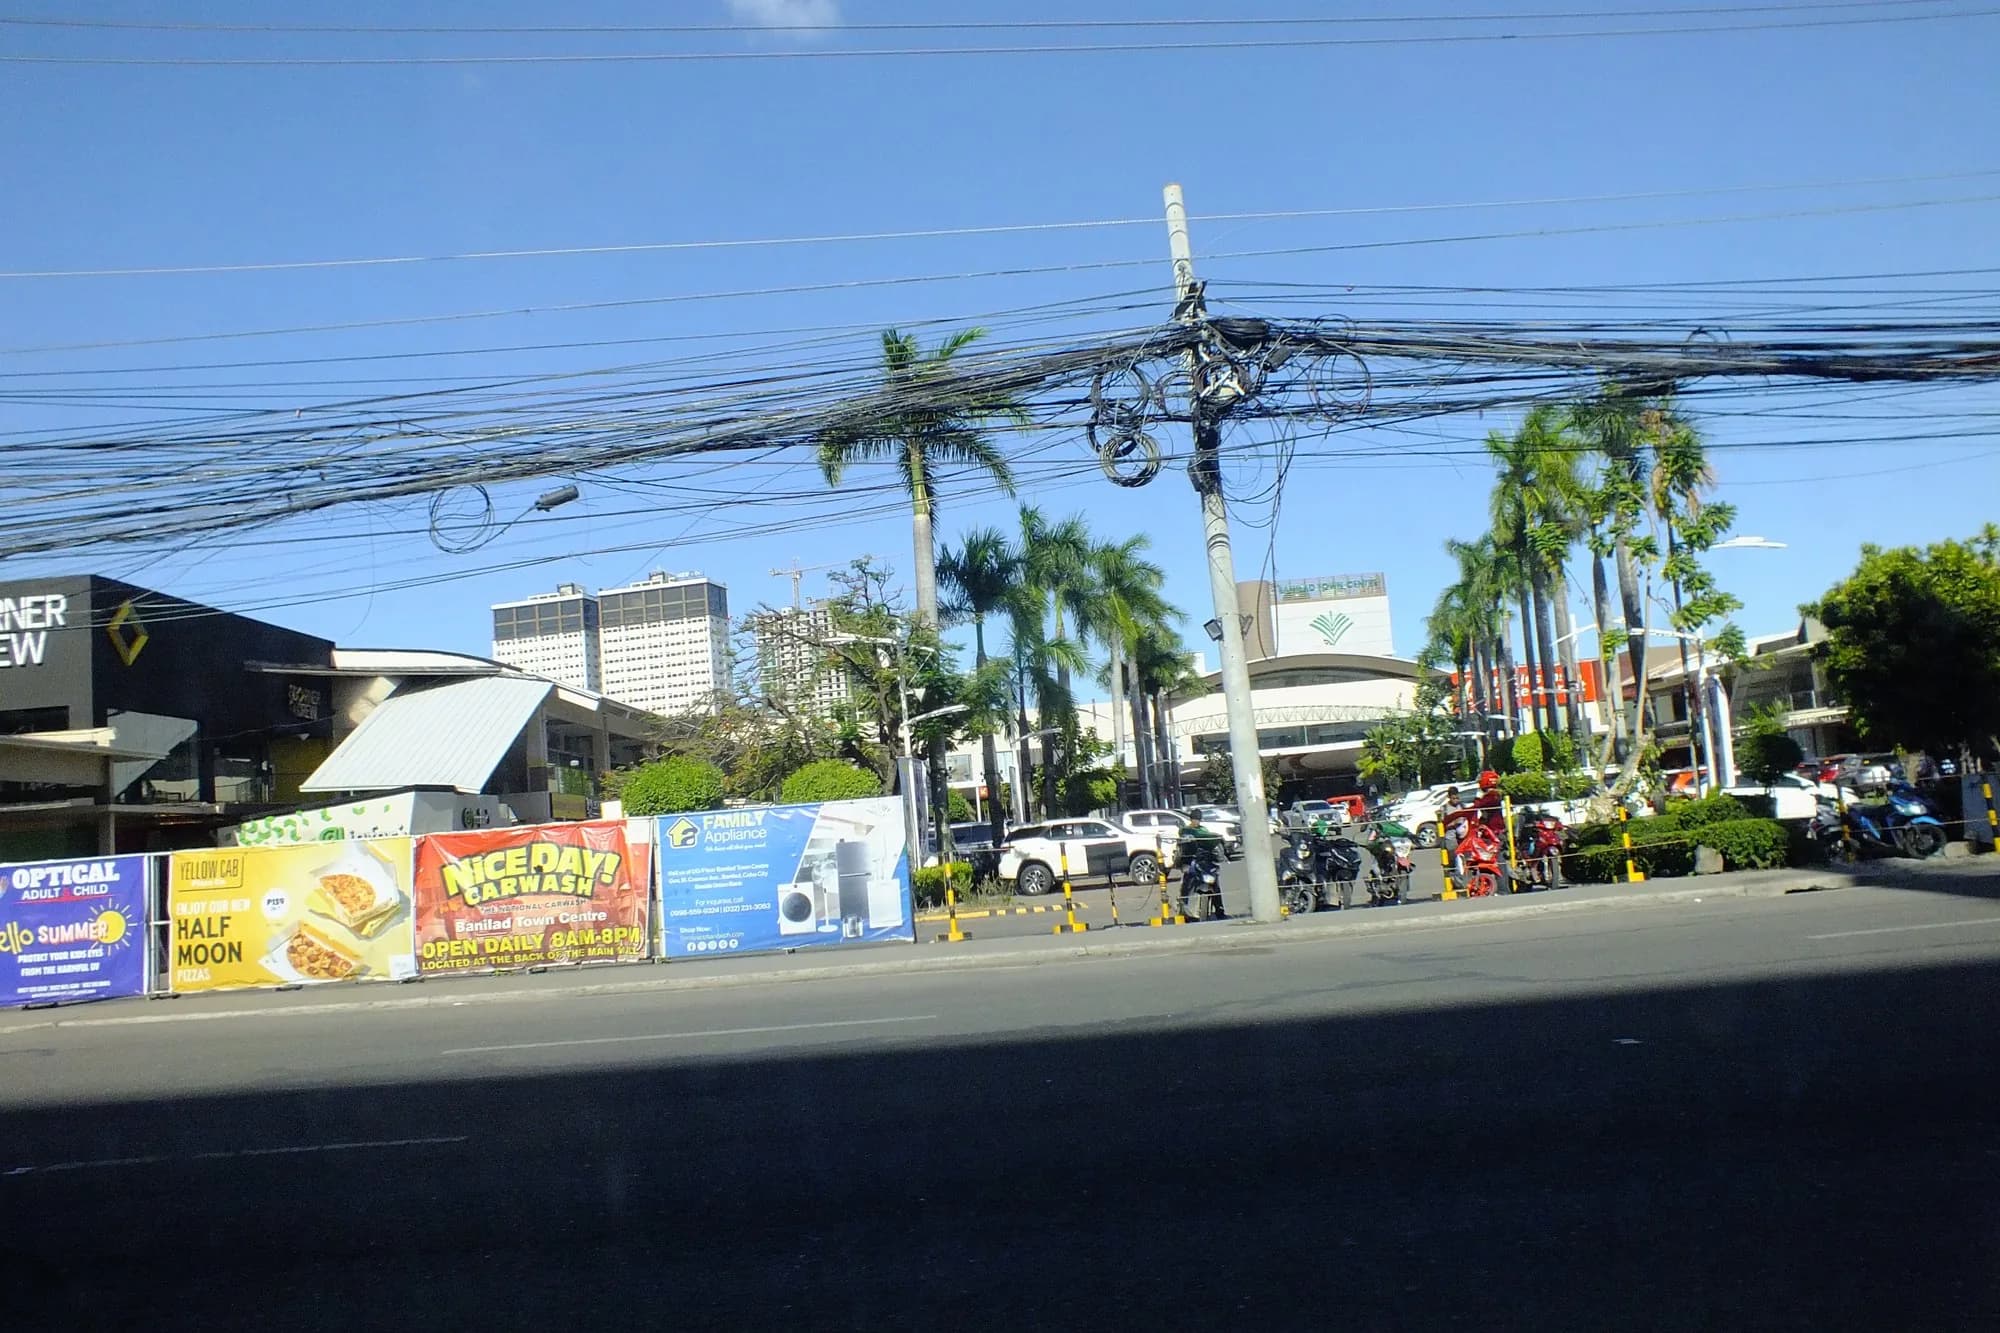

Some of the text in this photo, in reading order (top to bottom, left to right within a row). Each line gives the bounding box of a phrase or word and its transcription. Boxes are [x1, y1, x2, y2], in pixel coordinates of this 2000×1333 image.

[0, 593, 67, 631] NER
[703, 811, 767, 830] FAMILY
[704, 828, 767, 844] Appliance
[180, 858, 239, 880] YELLOW CAB
[530, 842, 621, 884] DAY!
[12, 862, 120, 889] OPTICAL
[22, 887, 61, 901] ADULT
[73, 884, 108, 896] CHILD
[464, 874, 593, 905] CARWASH
[545, 899, 587, 909] CARWASH
[38, 921, 109, 944] SUMMER
[177, 916, 232, 940] HALF
[455, 911, 608, 933] Banilad Town Centre
[177, 941, 243, 966] MOON
[422, 927, 640, 959] OPEN DAILY 8AM-8PM
[422, 959, 470, 970] LOCATED
[473, 957, 486, 966] AT
[489, 956, 512, 964] THE
[514, 952, 544, 963] BACK
[566, 949, 585, 958] THE
[588, 946, 614, 956] MAIN
[176, 968, 211, 982] PIZZAS
